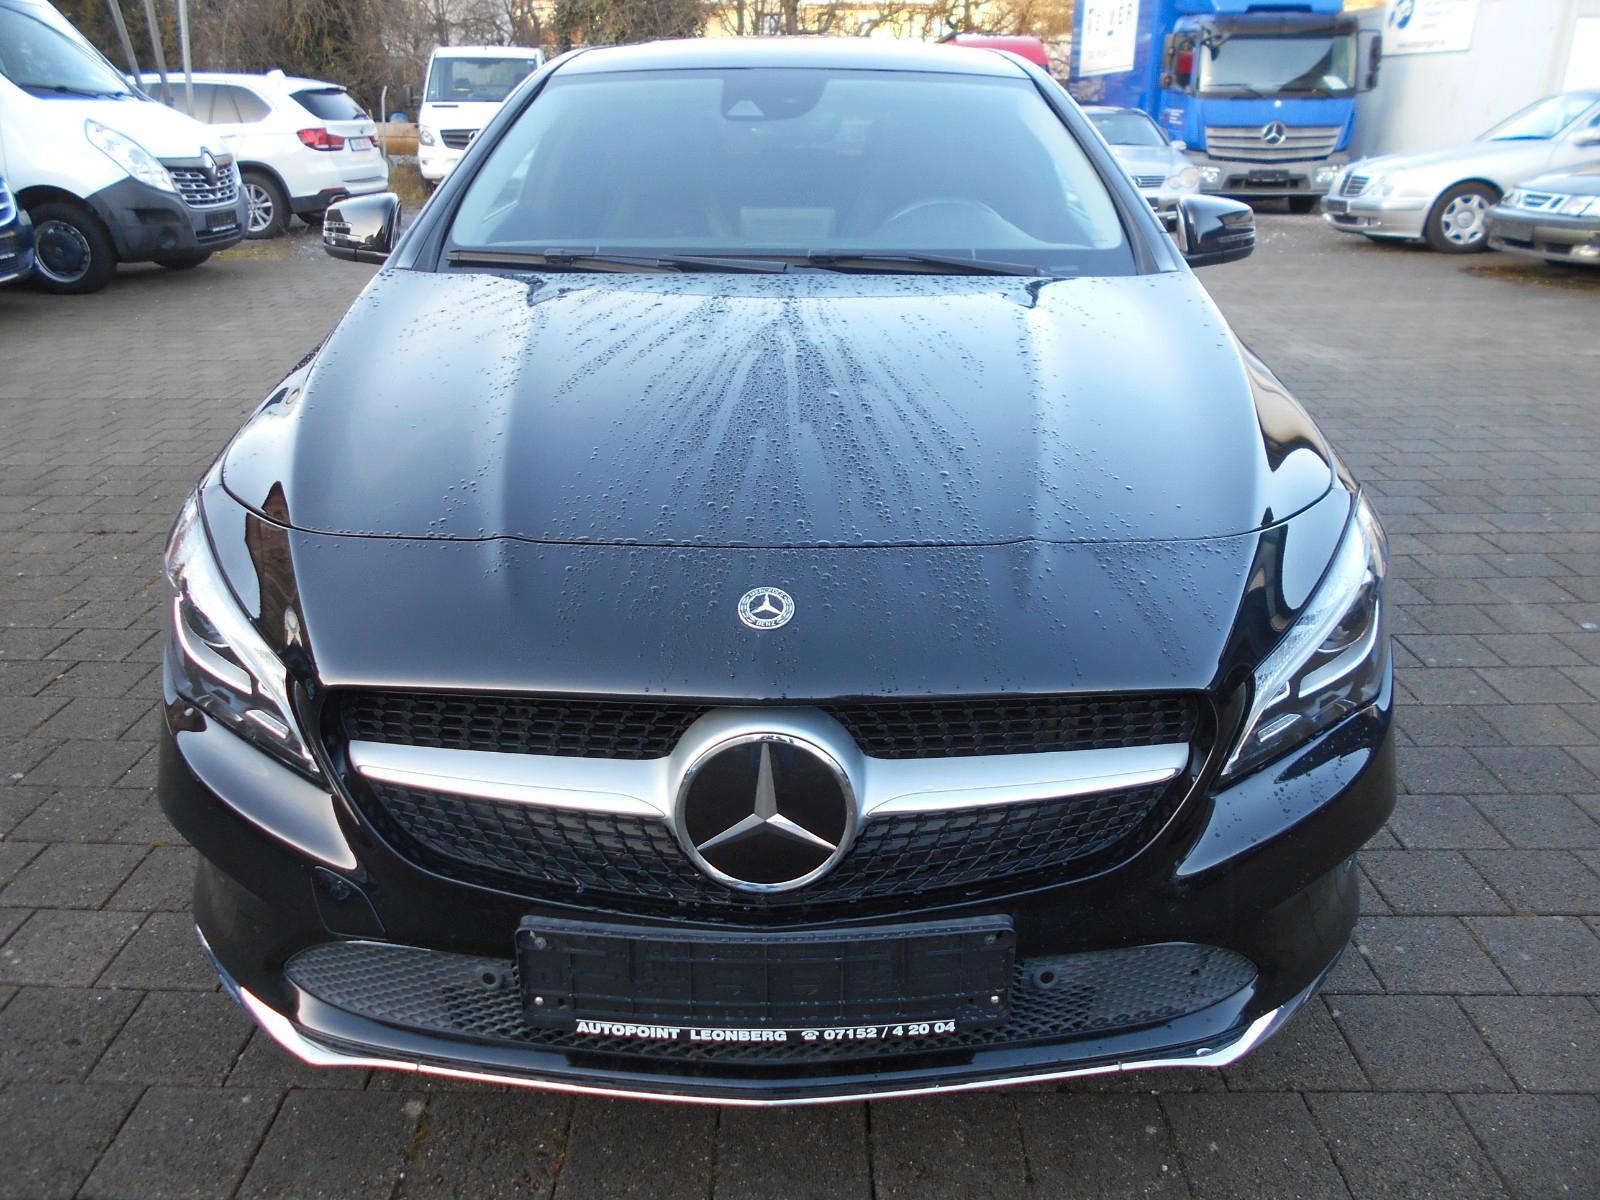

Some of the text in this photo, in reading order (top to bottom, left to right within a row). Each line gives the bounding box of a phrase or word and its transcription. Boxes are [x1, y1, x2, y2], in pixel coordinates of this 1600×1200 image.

[576, 1021, 680, 1039] AUTOPOINT
[690, 1029, 787, 1041] LEONBERG
[823, 1027, 877, 1040] 07152
[892, 1025, 903, 1036] 4
[908, 1023, 930, 1035] 20
[934, 1021, 956, 1033] 04
